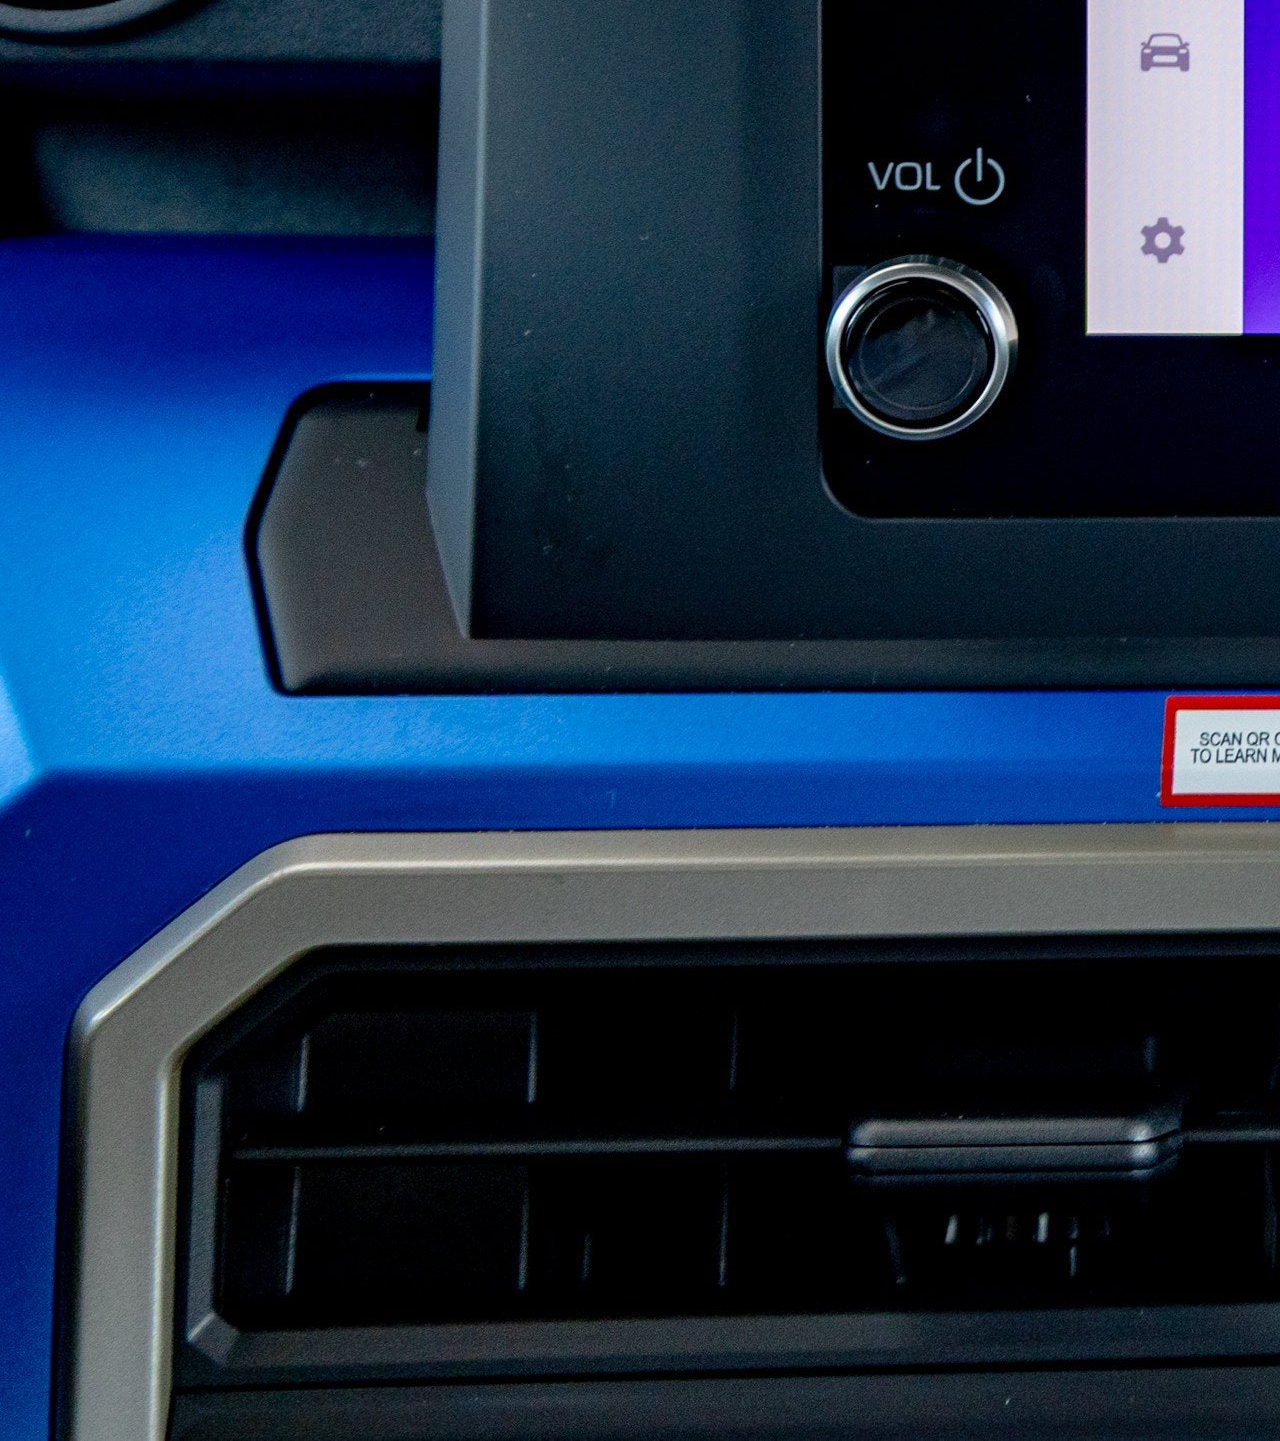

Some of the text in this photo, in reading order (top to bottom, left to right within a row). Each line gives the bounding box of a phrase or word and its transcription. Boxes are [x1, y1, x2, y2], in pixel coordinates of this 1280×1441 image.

[867, 161, 941, 191] VOL
[1200, 732, 1242, 746] SCAN
[1246, 732, 1270, 746] QR
[1191, 748, 1212, 764] TO
[1216, 748, 1268, 763] LEARN
